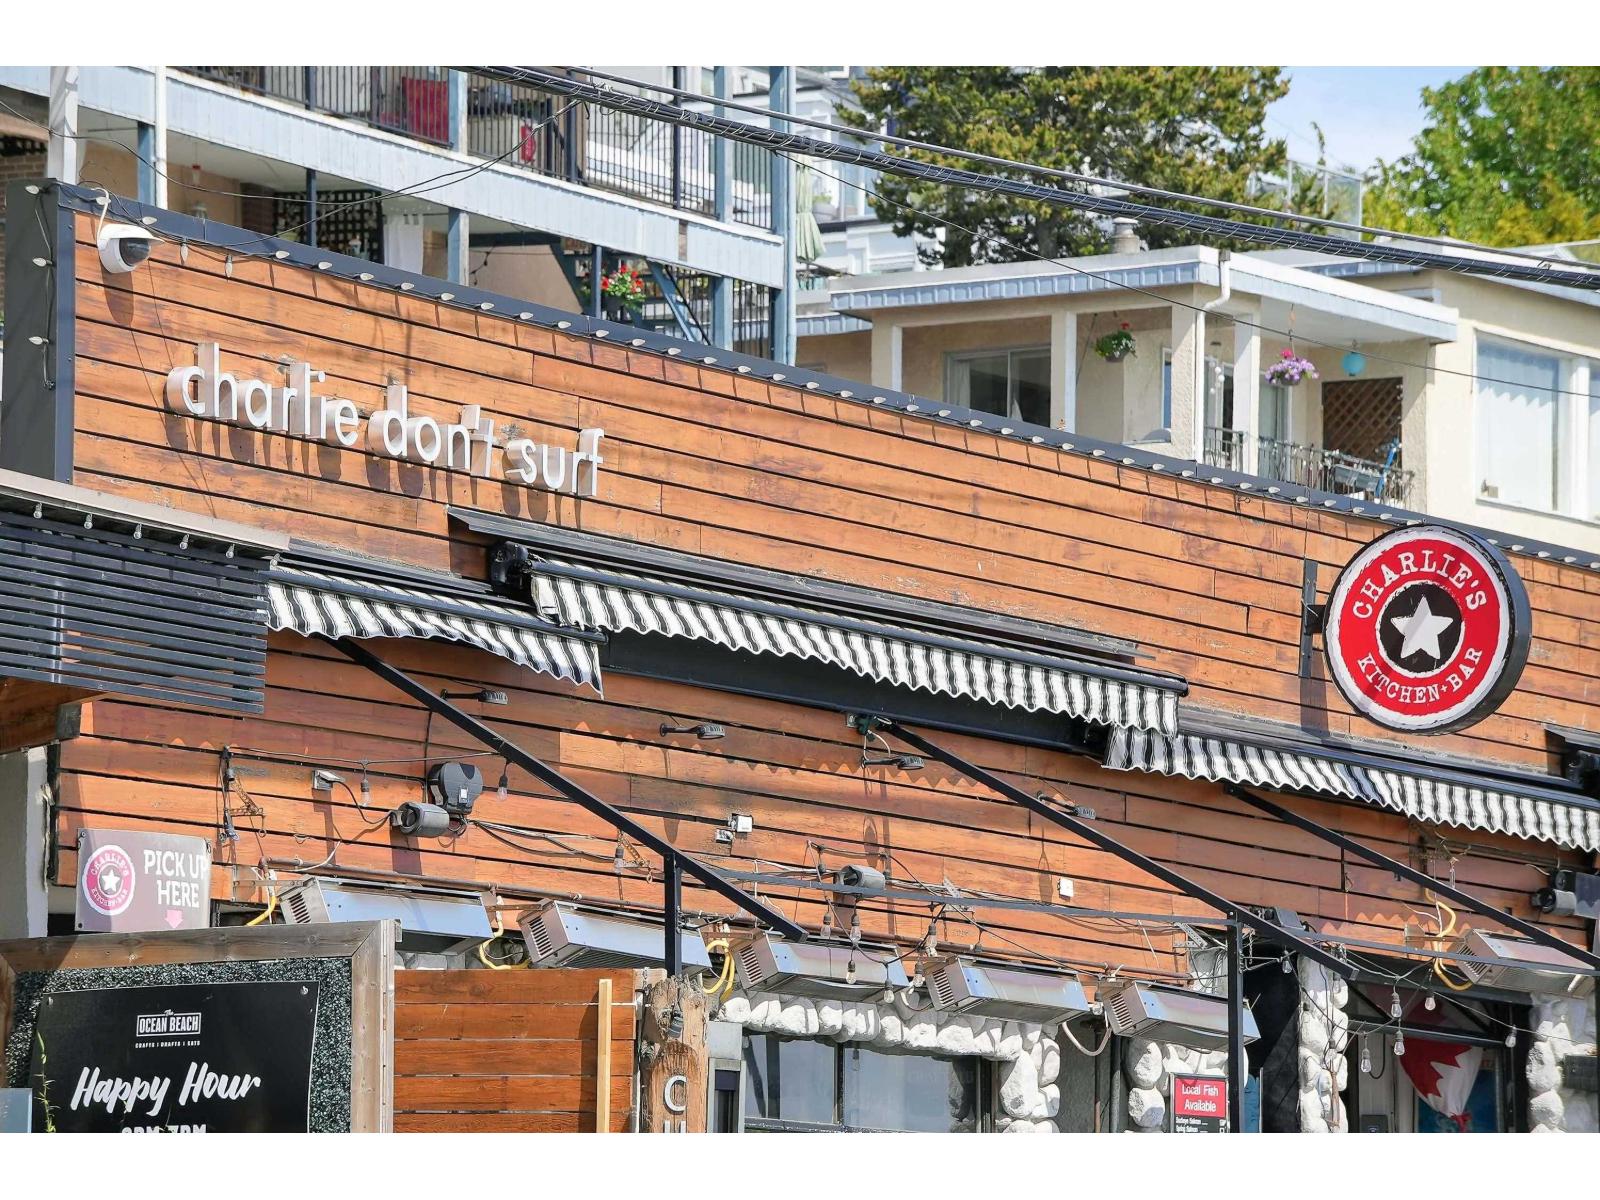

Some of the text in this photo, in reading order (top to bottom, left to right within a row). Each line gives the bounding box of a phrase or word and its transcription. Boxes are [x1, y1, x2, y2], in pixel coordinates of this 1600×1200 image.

[165, 342, 605, 497] charlie don't surf
[1353, 550, 1487, 619] CHARLIE'S
[143, 849, 210, 880] PICK UP
[157, 880, 200, 908] HERE
[139, 1015, 199, 1034] OCEAN BEACH
[164, 1009, 174, 1017] The
[70, 1061, 262, 1117] Happy Hour
[1182, 1084, 1219, 1097] Local Fish
[1184, 1099, 1217, 1113] Available
